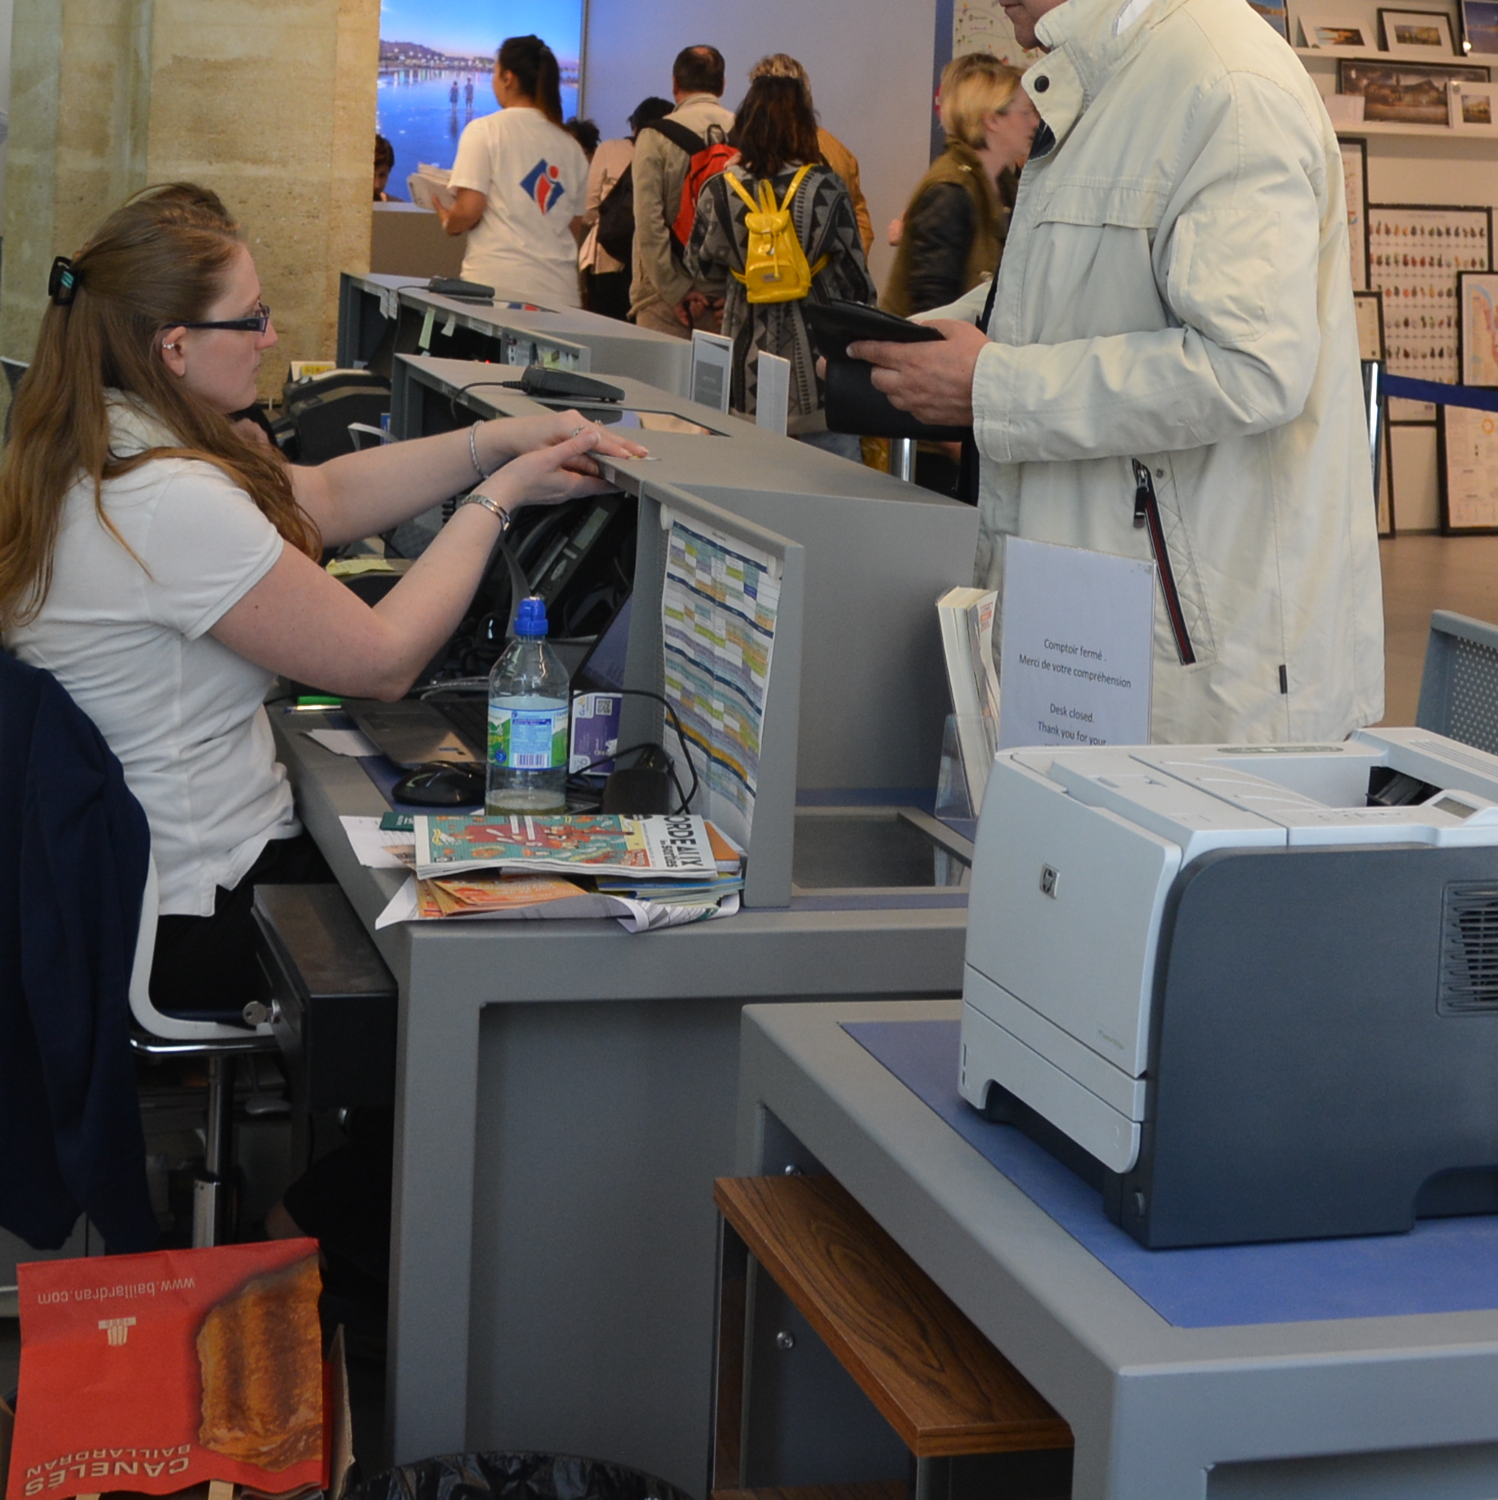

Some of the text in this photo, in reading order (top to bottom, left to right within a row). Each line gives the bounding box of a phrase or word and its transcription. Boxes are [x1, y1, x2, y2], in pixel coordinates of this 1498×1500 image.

[1044, 638, 1103, 661] Comptoir fermé
[1019, 654, 1132, 689] Merci de votre compréhension
[1050, 703, 1095, 723] Desk closed.
[1038, 721, 1106, 746] Thank you for your
[37, 1277, 195, 1305] www.baillardran.com
[26, 1443, 191, 1478] BAILLARDRAN
[24, 1456, 190, 1497] CANELÉS
